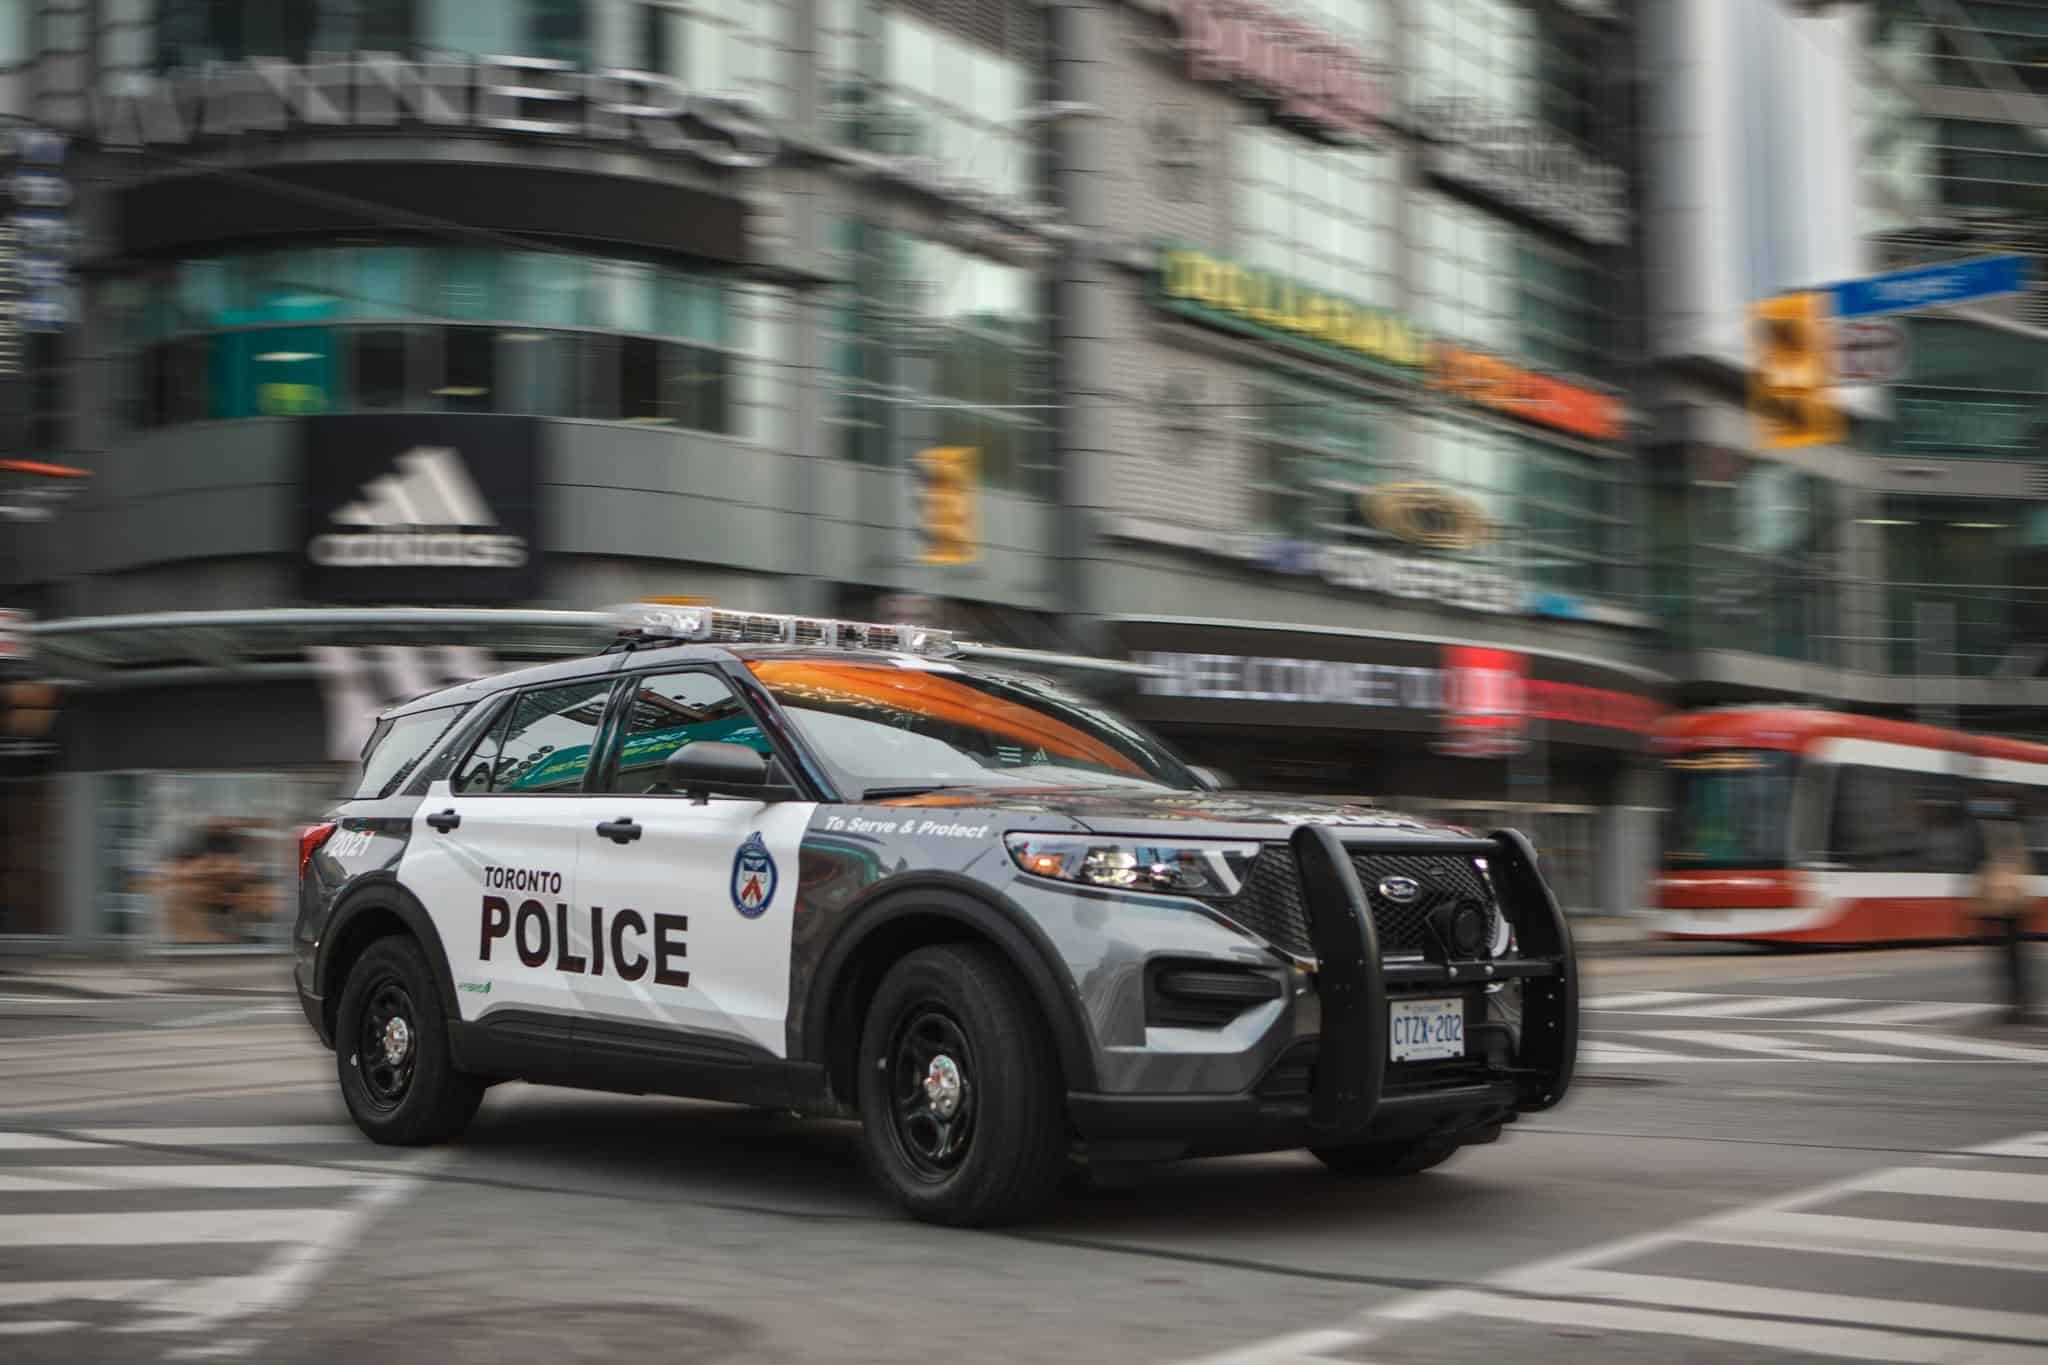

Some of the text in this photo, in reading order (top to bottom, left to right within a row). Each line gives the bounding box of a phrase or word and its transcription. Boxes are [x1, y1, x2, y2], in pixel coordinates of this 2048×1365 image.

[825, 815, 989, 840] To Serve & Protect
[485, 866, 562, 895] TORONTO
[479, 895, 690, 988] POLICE
